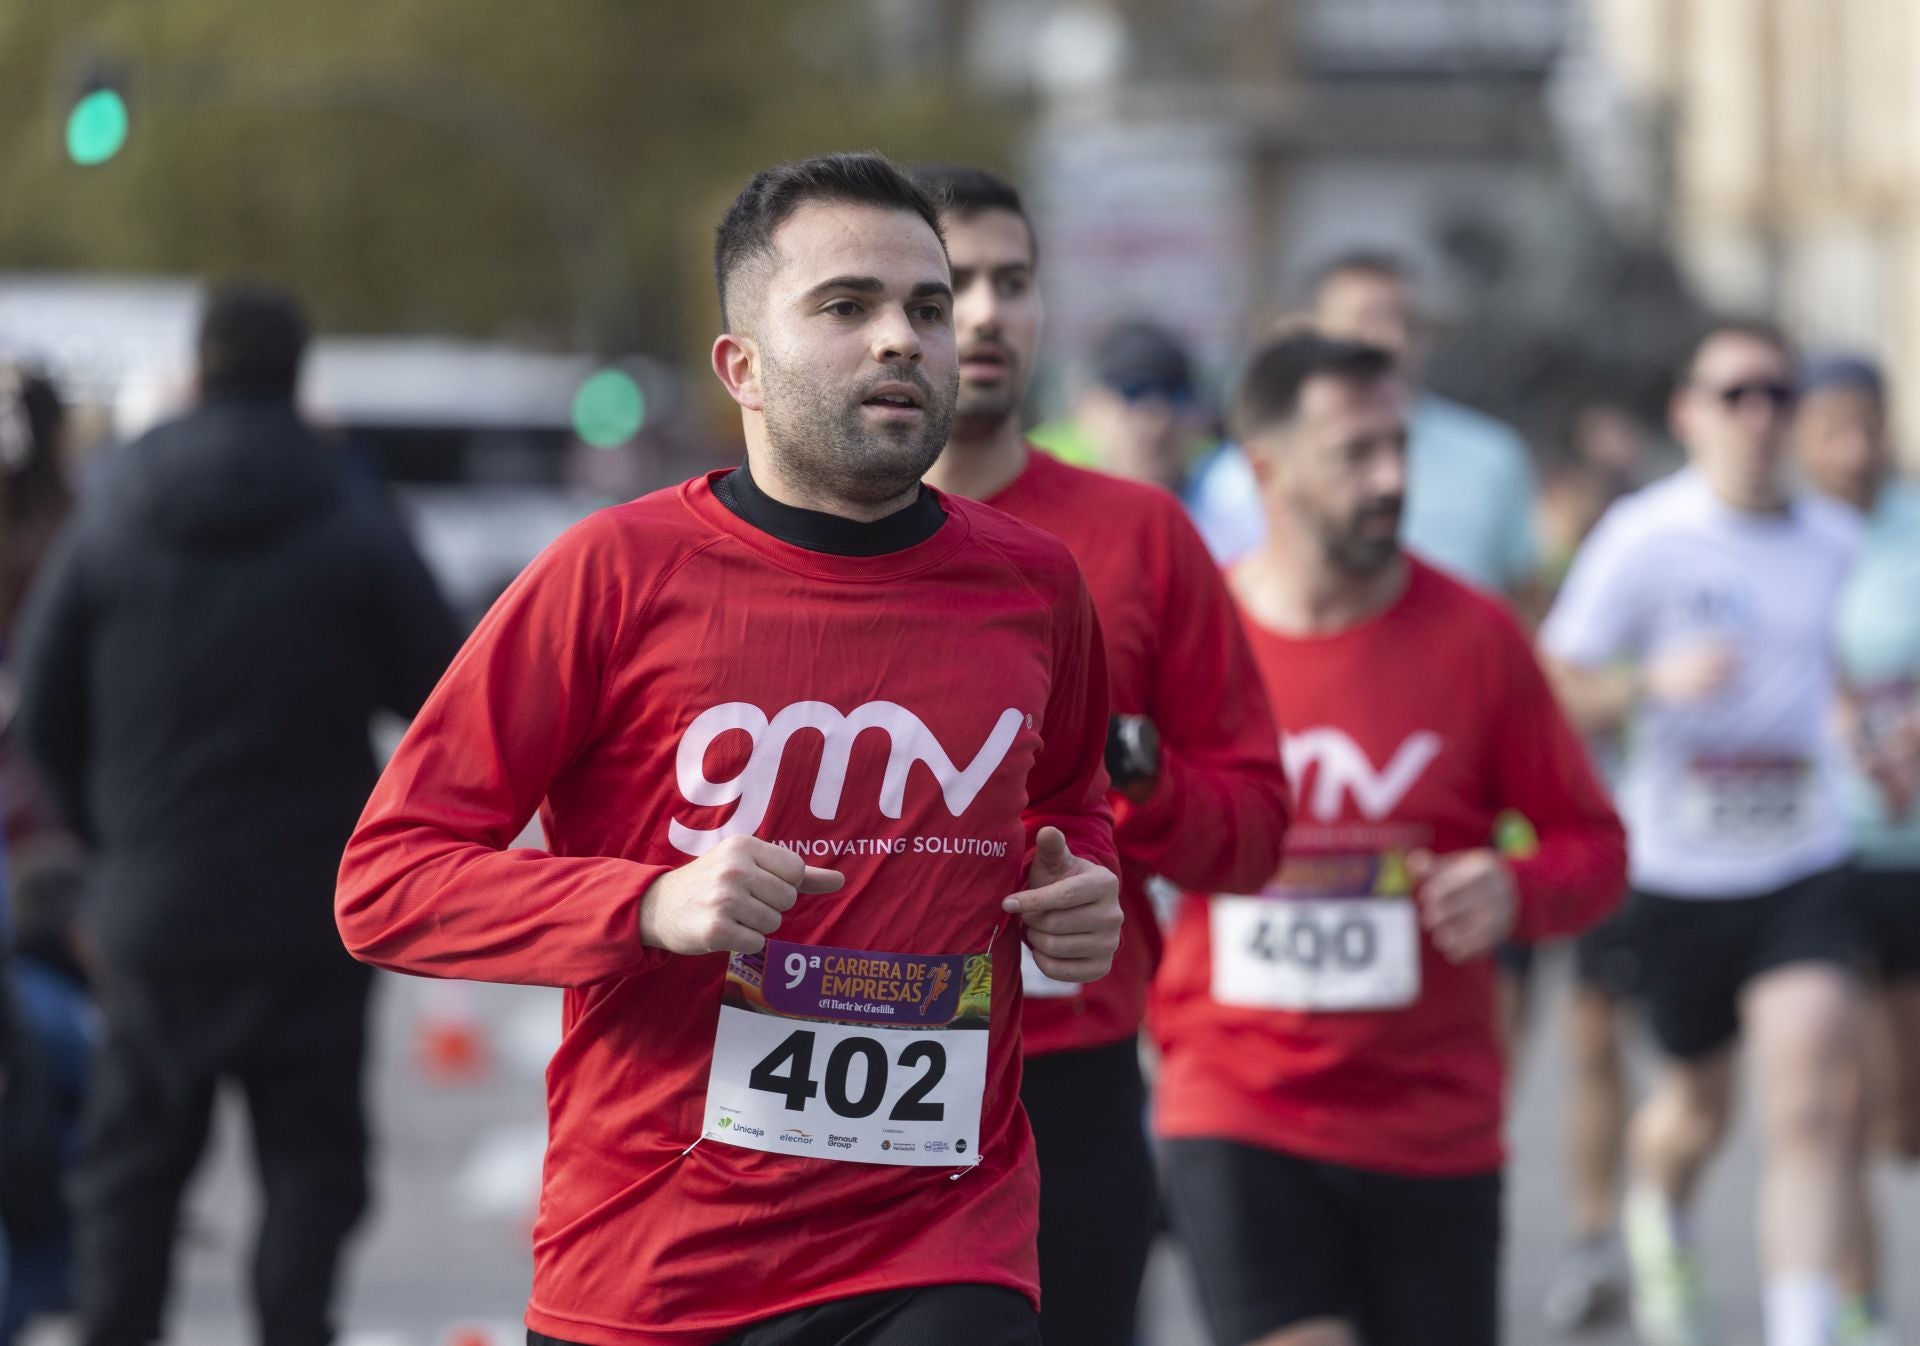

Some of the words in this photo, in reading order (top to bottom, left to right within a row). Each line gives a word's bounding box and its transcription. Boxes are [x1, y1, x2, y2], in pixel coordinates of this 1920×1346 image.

[668, 700, 1024, 857] gmv
[1279, 727, 1443, 822] mv
[771, 837, 907, 856] NNOVATING
[912, 836, 1008, 858] SOLUTIONS
[823, 955, 902, 980] CARRERA
[906, 962, 927, 981] DE
[820, 975, 923, 1003] EMPRESAS
[818, 998, 830, 1009] El
[832, 1000, 853, 1012] Norte
[854, 1002, 864, 1012] de
[863, 1002, 895, 1015] Castilla
[748, 1029, 947, 1122] 402
[733, 1123, 765, 1138] Unicaja
[779, 1134, 814, 1145] elecnor
[828, 1134, 858, 1144] Renault
[827, 1140, 852, 1149] Group
